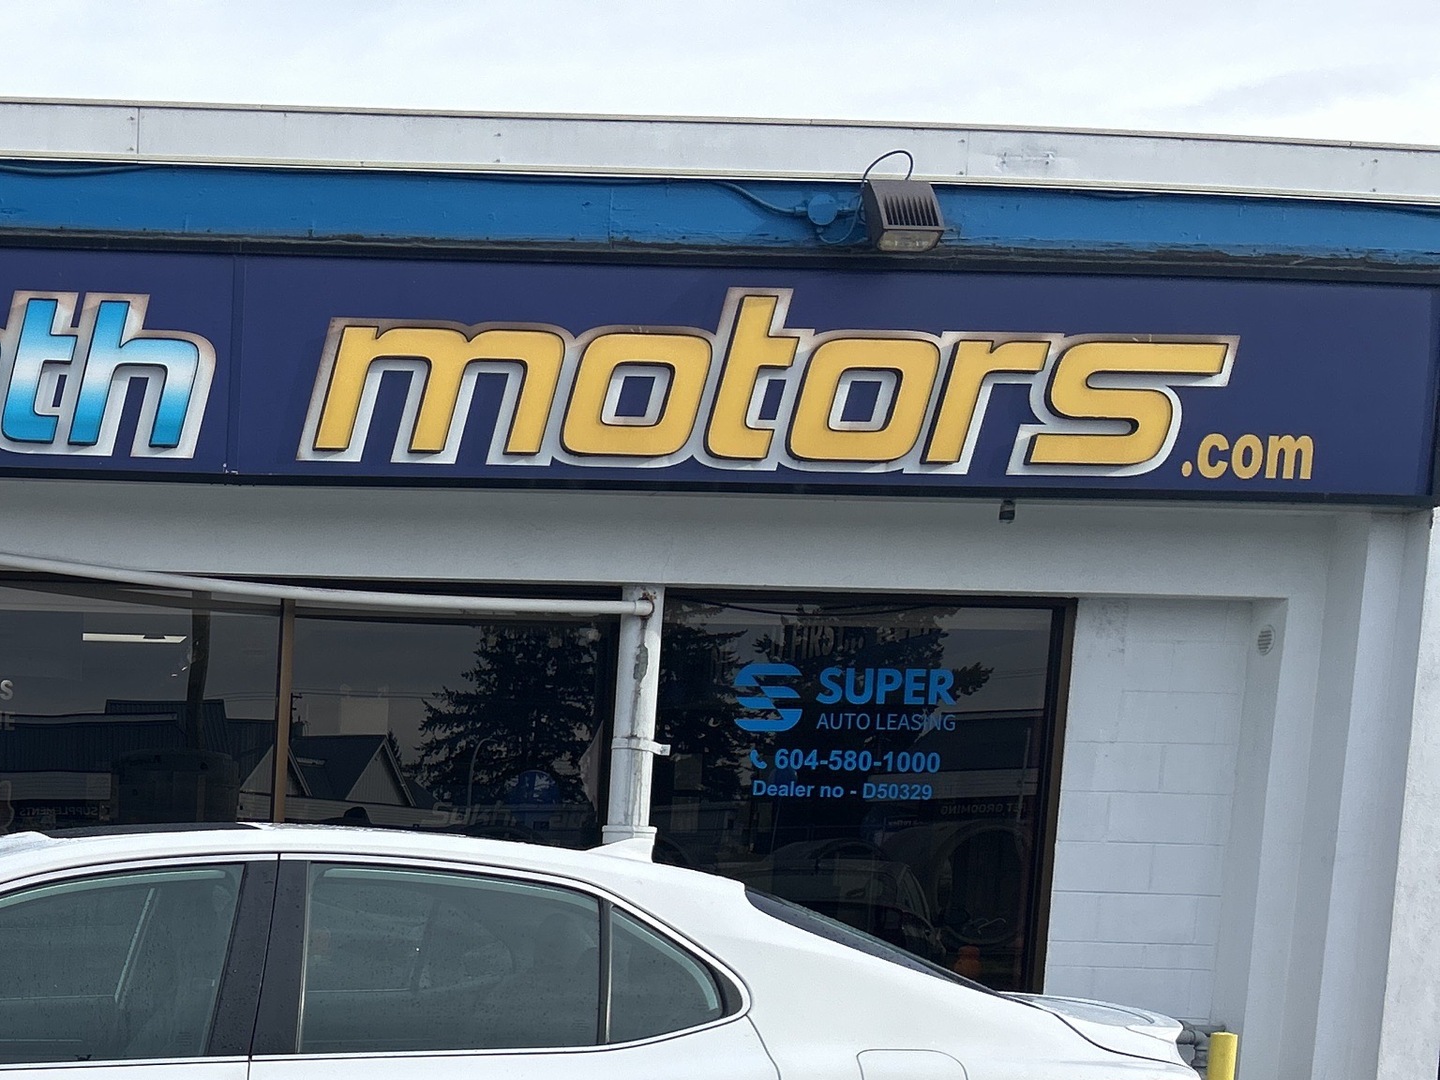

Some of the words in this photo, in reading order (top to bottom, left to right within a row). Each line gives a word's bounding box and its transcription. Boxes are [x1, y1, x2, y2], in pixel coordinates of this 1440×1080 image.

[296, 288, 1240, 477] motors
[1180, 432, 1315, 481] .com
[815, 666, 957, 706] SUPER
[816, 712, 870, 730] AUTO
[876, 712, 956, 732] LEASING
[774, 748, 941, 774] 604-580-1000
[752, 779, 815, 798] Dealer
[820, 784, 845, 798] no
[862, 782, 933, 800] D50329
